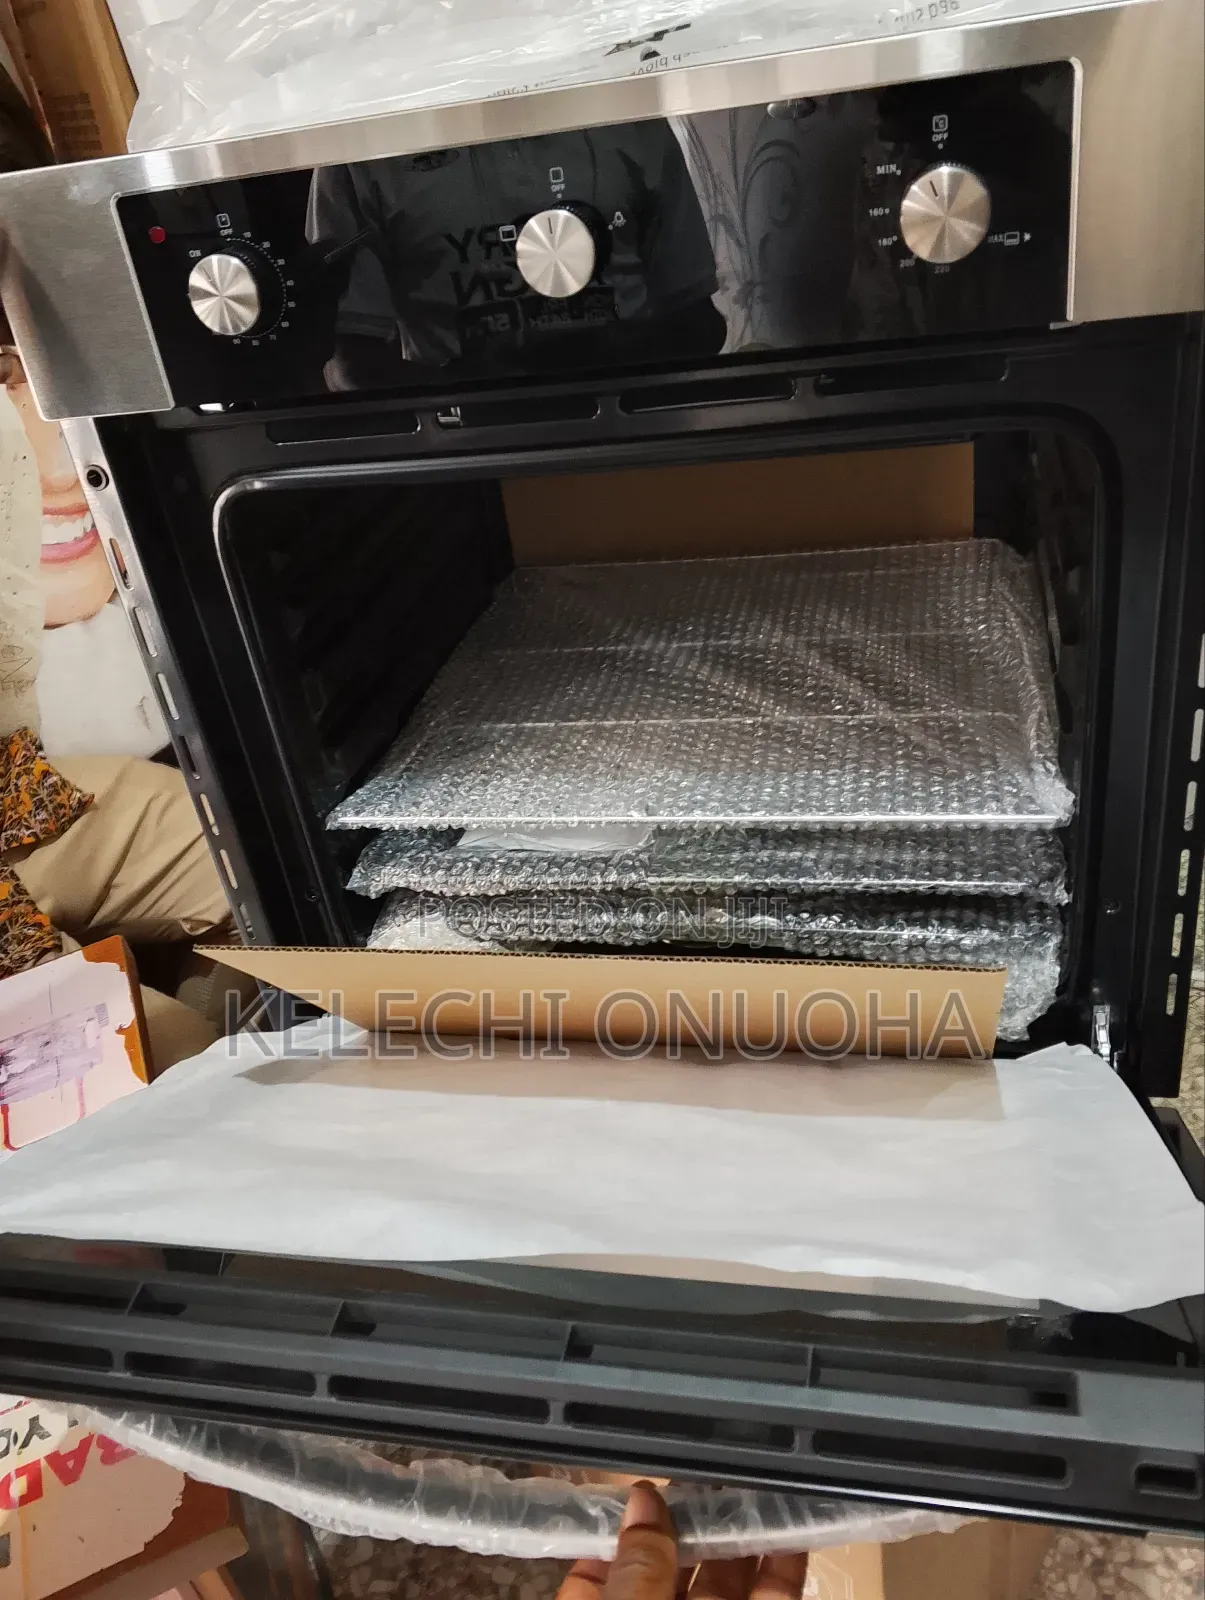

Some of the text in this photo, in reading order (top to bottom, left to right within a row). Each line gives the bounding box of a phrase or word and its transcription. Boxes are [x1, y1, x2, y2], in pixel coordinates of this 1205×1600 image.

[932, 133, 949, 143] OFF
[876, 164, 897, 175] MIN
[551, 183, 566, 192] OFF
